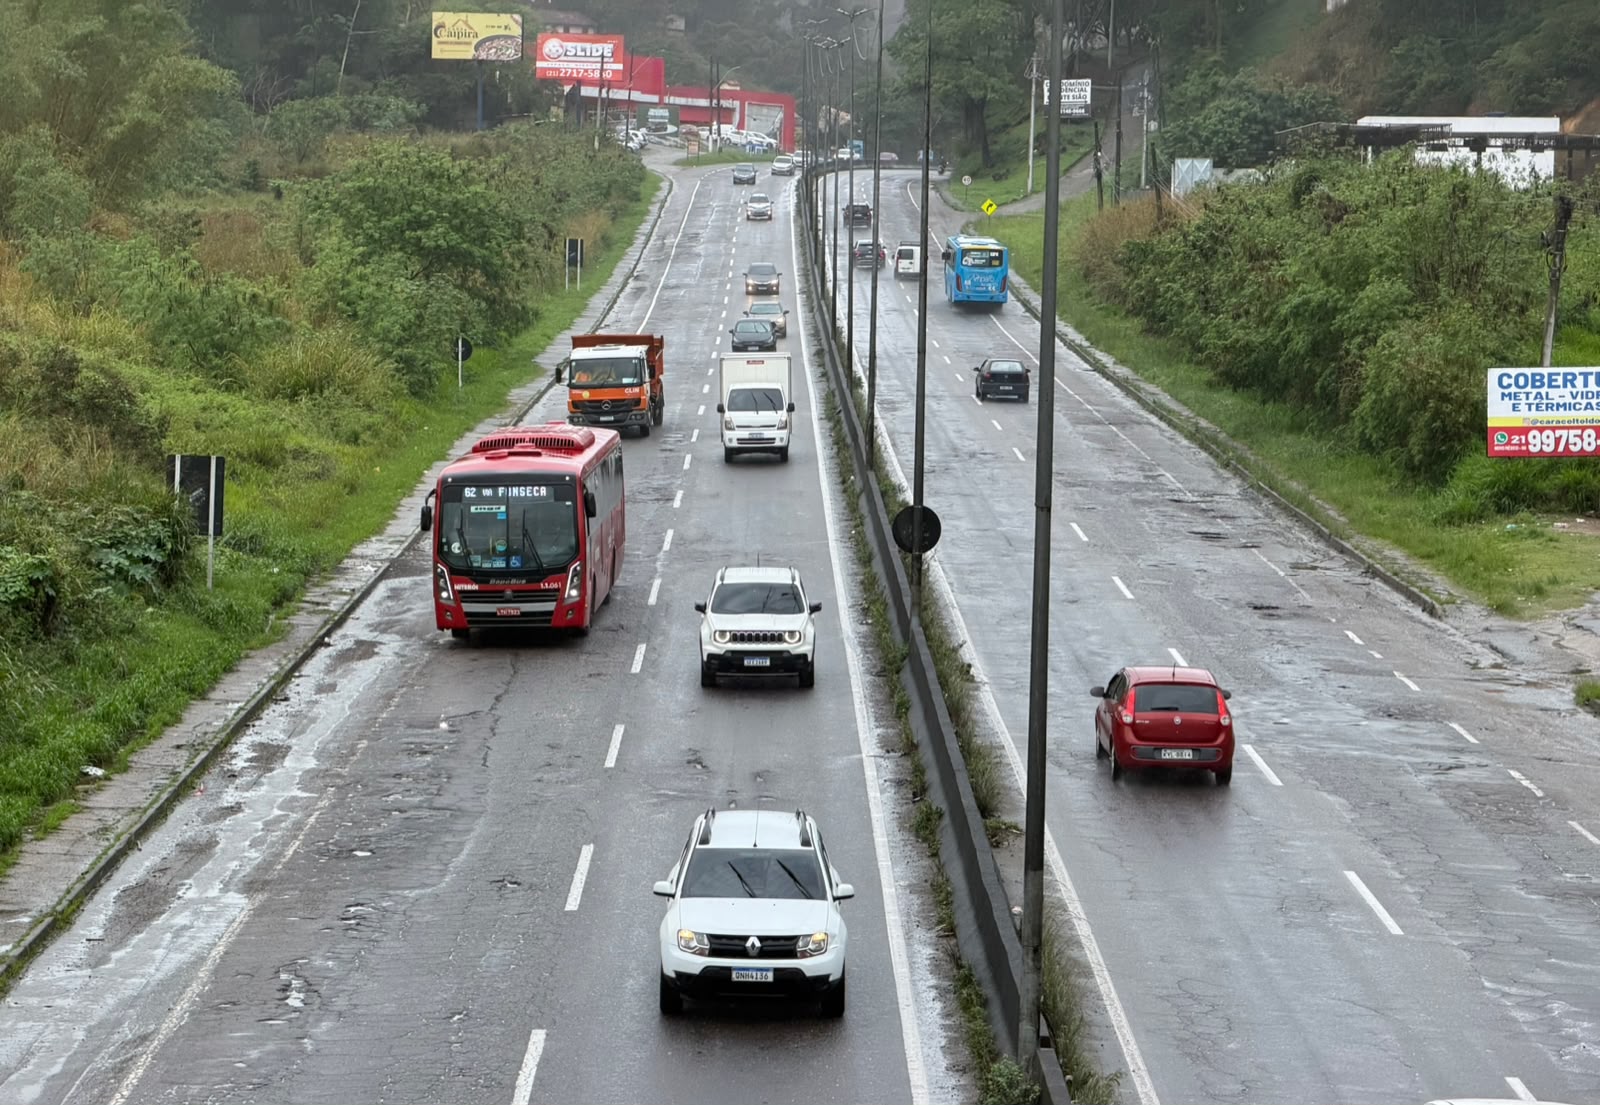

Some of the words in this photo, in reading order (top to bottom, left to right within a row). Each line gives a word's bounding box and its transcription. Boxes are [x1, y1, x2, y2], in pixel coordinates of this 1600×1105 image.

[565, 44, 613, 57] SLIDE
[1501, 391, 1554, 401] METAL
[1511, 402, 1521, 412] E
[1510, 435, 1526, 444] 21
[464, 487, 477, 497] 62
